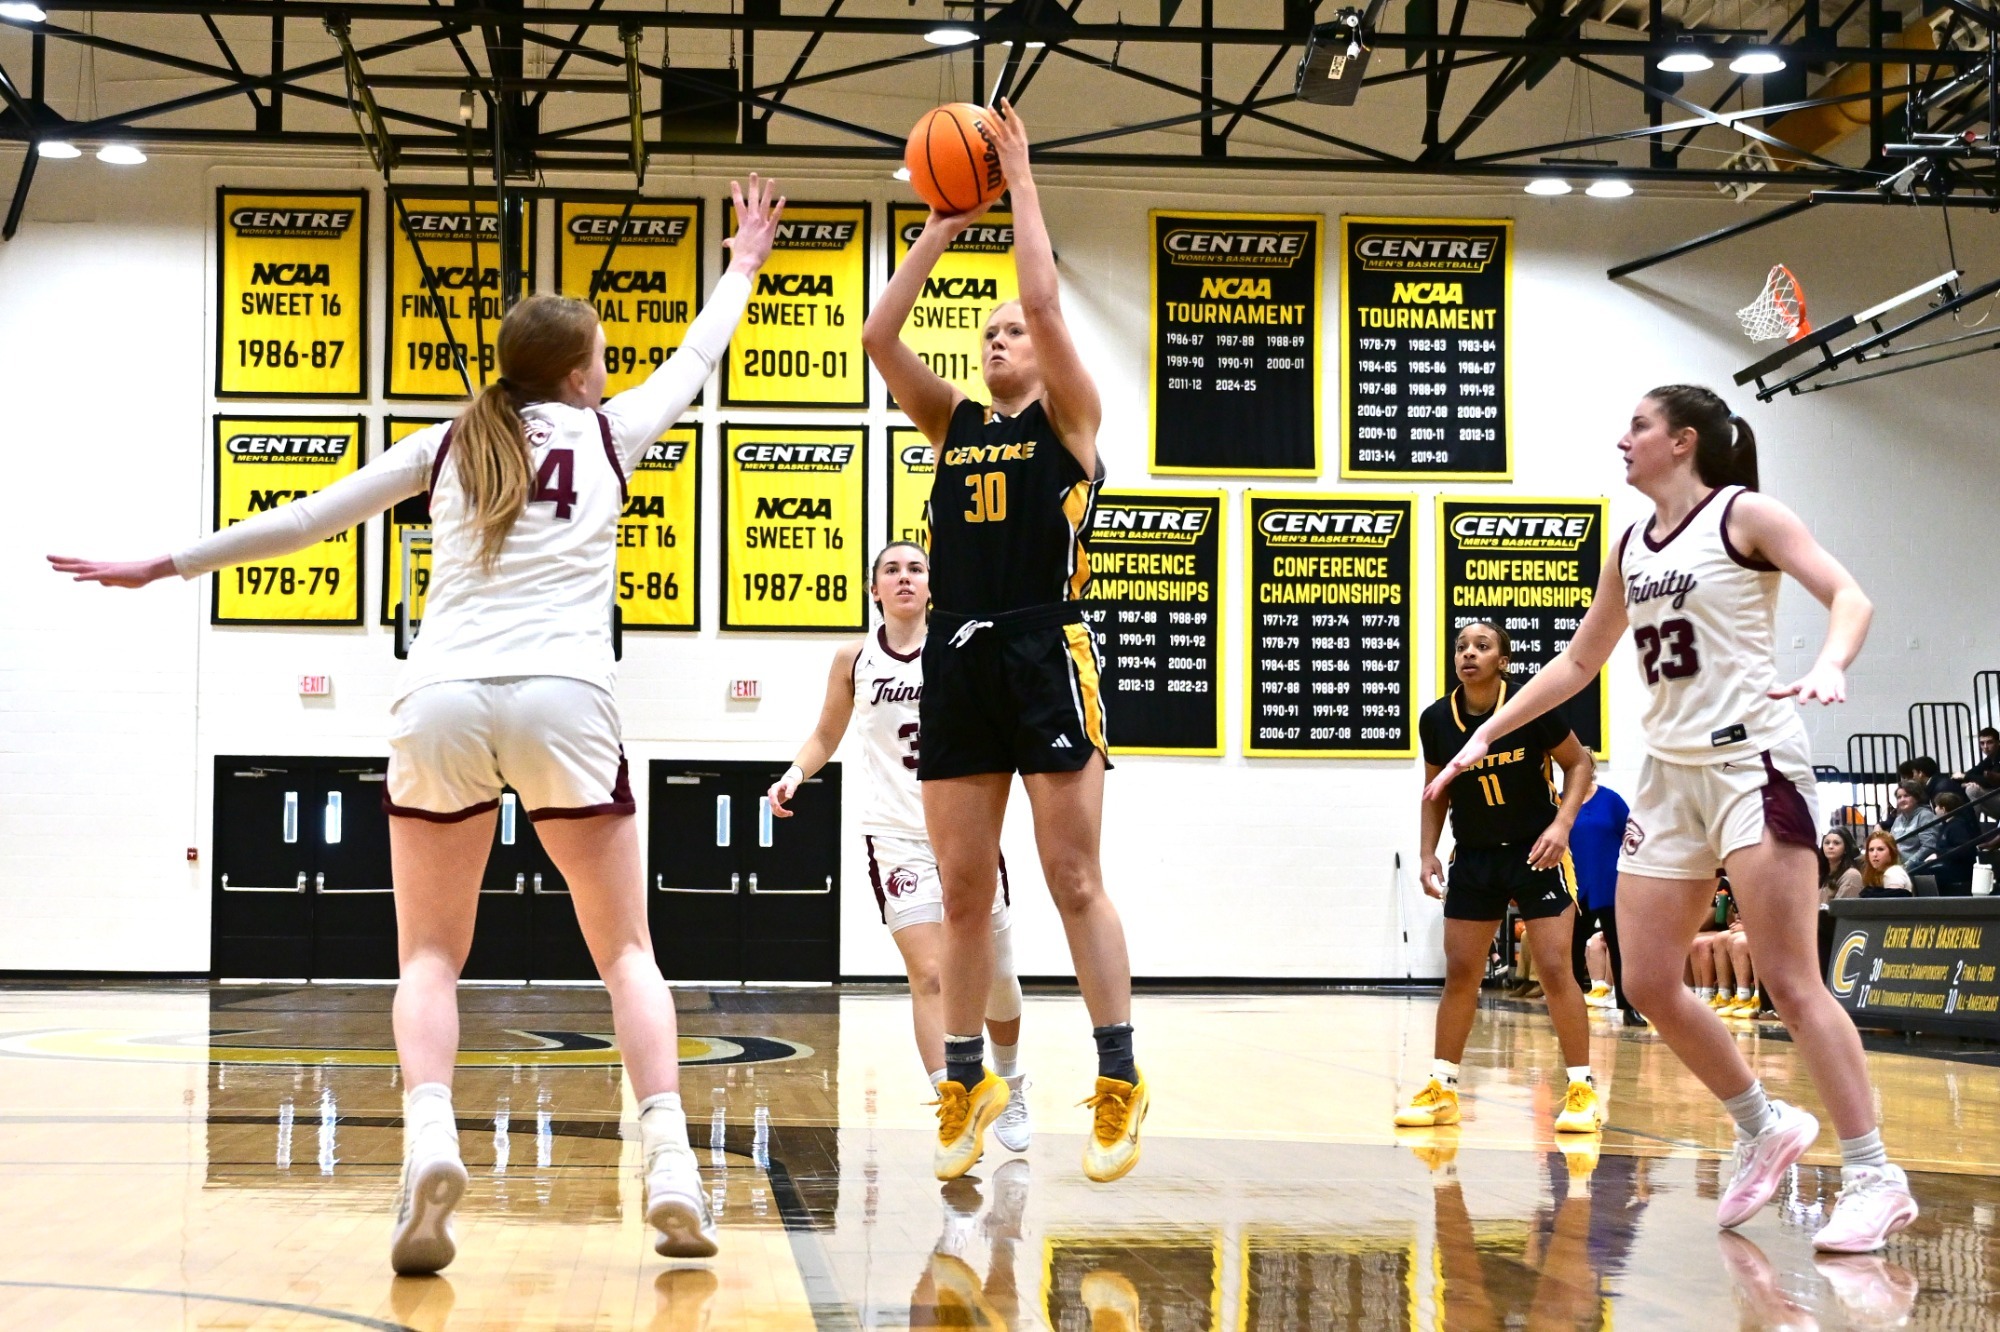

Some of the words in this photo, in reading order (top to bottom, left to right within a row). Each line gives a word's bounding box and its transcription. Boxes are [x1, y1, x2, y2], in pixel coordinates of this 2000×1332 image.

[234, 211, 350, 228] CENTRE
[408, 216, 497, 231] CENTR
[572, 219, 684, 236] CENTRE
[790, 240, 842, 248] BASKETBALL
[1169, 234, 1300, 253] CENTRE
[1360, 240, 1490, 259] CENTRE
[1178, 254, 1222, 262] WOMEN'S
[1226, 255, 1289, 263] BASKETBALL
[1407, 260, 1479, 269] BASKETBALL
[251, 264, 329, 286] NCAA
[589, 270, 666, 293] NCAA
[757, 274, 833, 296] NCAA
[922, 278, 997, 299] NCAA
[1201, 278, 1271, 299] NCAA
[1392, 282, 1463, 304] NCAA
[242, 293, 314, 316] SWEET
[322, 295, 341, 316] 16
[637, 300, 687, 323] FOUR
[1166, 302, 1305, 325] TOURNAMENT
[748, 303, 817, 326] SWEET
[826, 305, 844, 326] 16
[914, 306, 981, 328] SWEET
[1358, 307, 1496, 330] TOURNAMENT
[1167, 333, 1203, 345] 1986-87
[1217, 335, 1254, 346] 1987-88
[1267, 336, 1304, 346] 1988-89
[1360, 338, 1396, 350] 1978-79
[1409, 339, 1446, 351] 1982-83
[1458, 339, 1496, 352] 1983-84
[238, 340, 344, 368] 1986-87
[745, 349, 847, 378] 2000-01
[1167, 356, 1204, 368] 1989-90
[1218, 357, 1253, 368] 1990-91
[1267, 358, 1304, 369] 2000-01
[1359, 360, 1397, 372] 1984-85
[1409, 361, 1446, 373] 1985-86
[1458, 361, 1496, 374] 1986-87
[1169, 378, 1201, 390] 2011-12
[1216, 379, 1256, 391] 2024-25
[1359, 382, 1397, 395] 1987-88
[1409, 383, 1447, 395] 1988-89
[1459, 384, 1495, 396] 1991-92
[1358, 405, 1398, 417] 2006-07
[1407, 405, 1448, 418] 2007-08
[1458, 406, 1497, 418] 2008-09
[1359, 427, 1397, 439] 2009-10
[1411, 428, 1444, 440] 2010-11
[1459, 428, 1495, 441] 2012-13
[229, 437, 345, 454] CENTRE
[736, 445, 849, 463] CENTRE
[945, 441, 1037, 466] CENTRE
[271, 455, 336, 463] BASKETBALL
[1359, 449, 1396, 462] 2013-14
[1411, 451, 1448, 463] 2019-20
[964, 472, 1006, 523] 30
[755, 498, 831, 520] NCAA
[1094, 510, 1204, 531] ENTRE
[1263, 514, 1395, 533] CENTRE
[1455, 517, 1586, 537] CENTRE
[657, 526, 676, 548] 16
[746, 527, 816, 549] SWEET
[824, 528, 843, 549] 16
[1128, 532, 1192, 540] BASKETBALL
[1272, 535, 1307, 543] MEN'S
[1310, 536, 1384, 544] BASKETBALL
[1463, 538, 1498, 546] MEN'S
[1502, 539, 1575, 548] BASKETBALL
[1273, 557, 1388, 578] CONFERENCE
[1466, 559, 1579, 582] CONFERENCE
[236, 566, 339, 595] 1978-79
[744, 574, 847, 601] 1987-88
[1626, 569, 1697, 609] Trinity
[1260, 583, 1401, 604] CHAMPIONSHIPS
[1454, 585, 1592, 608] CHAMPIONSHIPS
[1118, 611, 1157, 623] 1987-88
[1169, 612, 1207, 624] 1988-89
[1263, 614, 1298, 626] 1971-72
[1312, 615, 1349, 626] 1973-74
[1362, 615, 1400, 627] 1977-78
[1505, 618, 1539, 629] 2010-11
[1120, 634, 1156, 645] 1990-91
[1170, 635, 1206, 647] 1991-92
[1262, 637, 1299, 648] 1978-79
[1312, 637, 1350, 649] 1982-83
[1362, 637, 1400, 649] 1983-84
[1511, 640, 1540, 652] 014-15
[1634, 618, 1701, 685] 23
[1118, 657, 1156, 668] 1993-94
[1168, 657, 1206, 669] 2000-01
[1261, 659, 1300, 671] 1984-85
[1312, 660, 1350, 671] 1985-86
[1362, 660, 1400, 671] 1986-87
[304, 676, 326, 692] EXIT
[737, 680, 758, 696] EXIT
[1118, 679, 1155, 691] 2012-13
[1168, 680, 1208, 692] 2022-23
[1262, 682, 1300, 694] 1987-88
[1312, 682, 1350, 694] 1988-89
[1362, 682, 1400, 694] 1989-90
[1263, 705, 1298, 716] 1990-91
[1313, 705, 1348, 716] 1991-92
[1362, 705, 1400, 716] 1992-93
[1260, 727, 1300, 739] 2006-07
[1311, 727, 1351, 739] 2007-08
[1361, 728, 1401, 739] 2008-09
[1478, 773, 1506, 806] 11
[1883, 925, 1911, 948] CENTRE
[1911, 925, 1935, 949] MEN'S
[1936, 925, 1982, 949] BASKETBALL
[1869, 958, 1883, 982] 30
[1953, 960, 1963, 985] 2
[1961, 964, 1977, 981] FINAL
[1979, 964, 1996, 982] FOURS
[1857, 985, 1870, 1008] 17
[1945, 989, 1958, 1014] 10
